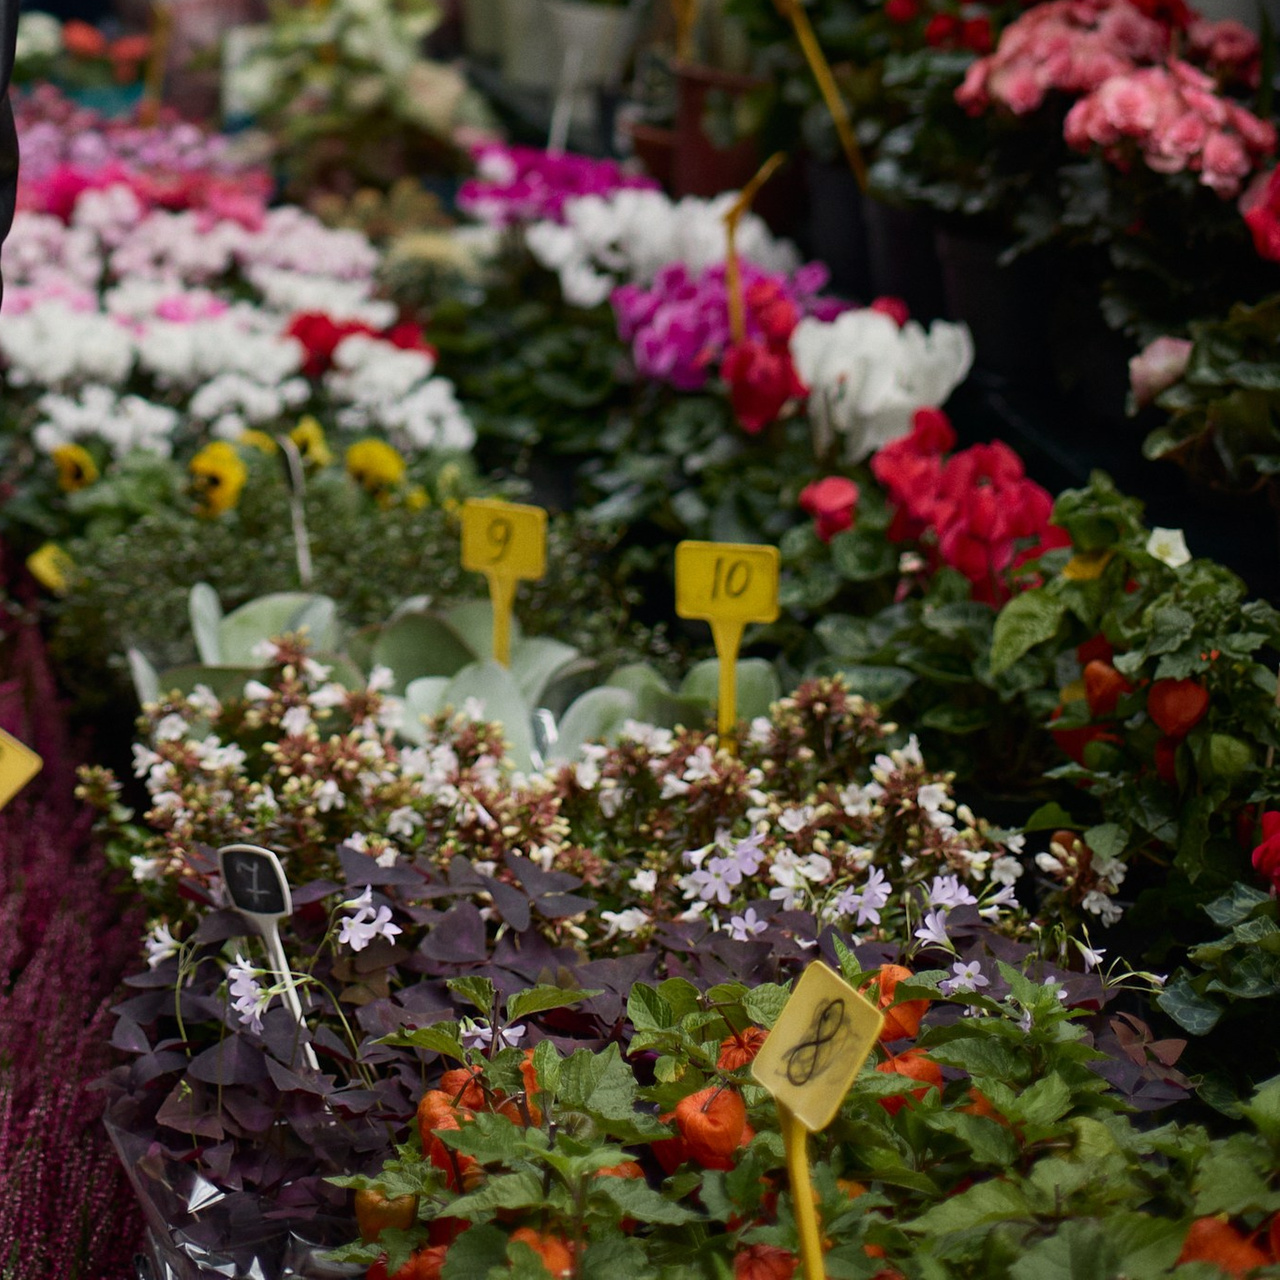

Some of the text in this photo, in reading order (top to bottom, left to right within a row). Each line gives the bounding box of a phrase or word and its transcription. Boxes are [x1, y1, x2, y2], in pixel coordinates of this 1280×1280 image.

[486, 517, 513, 565] 9
[710, 557, 753, 601] 10
[236, 860, 270, 904] 7
[786, 998, 845, 1087] 8
